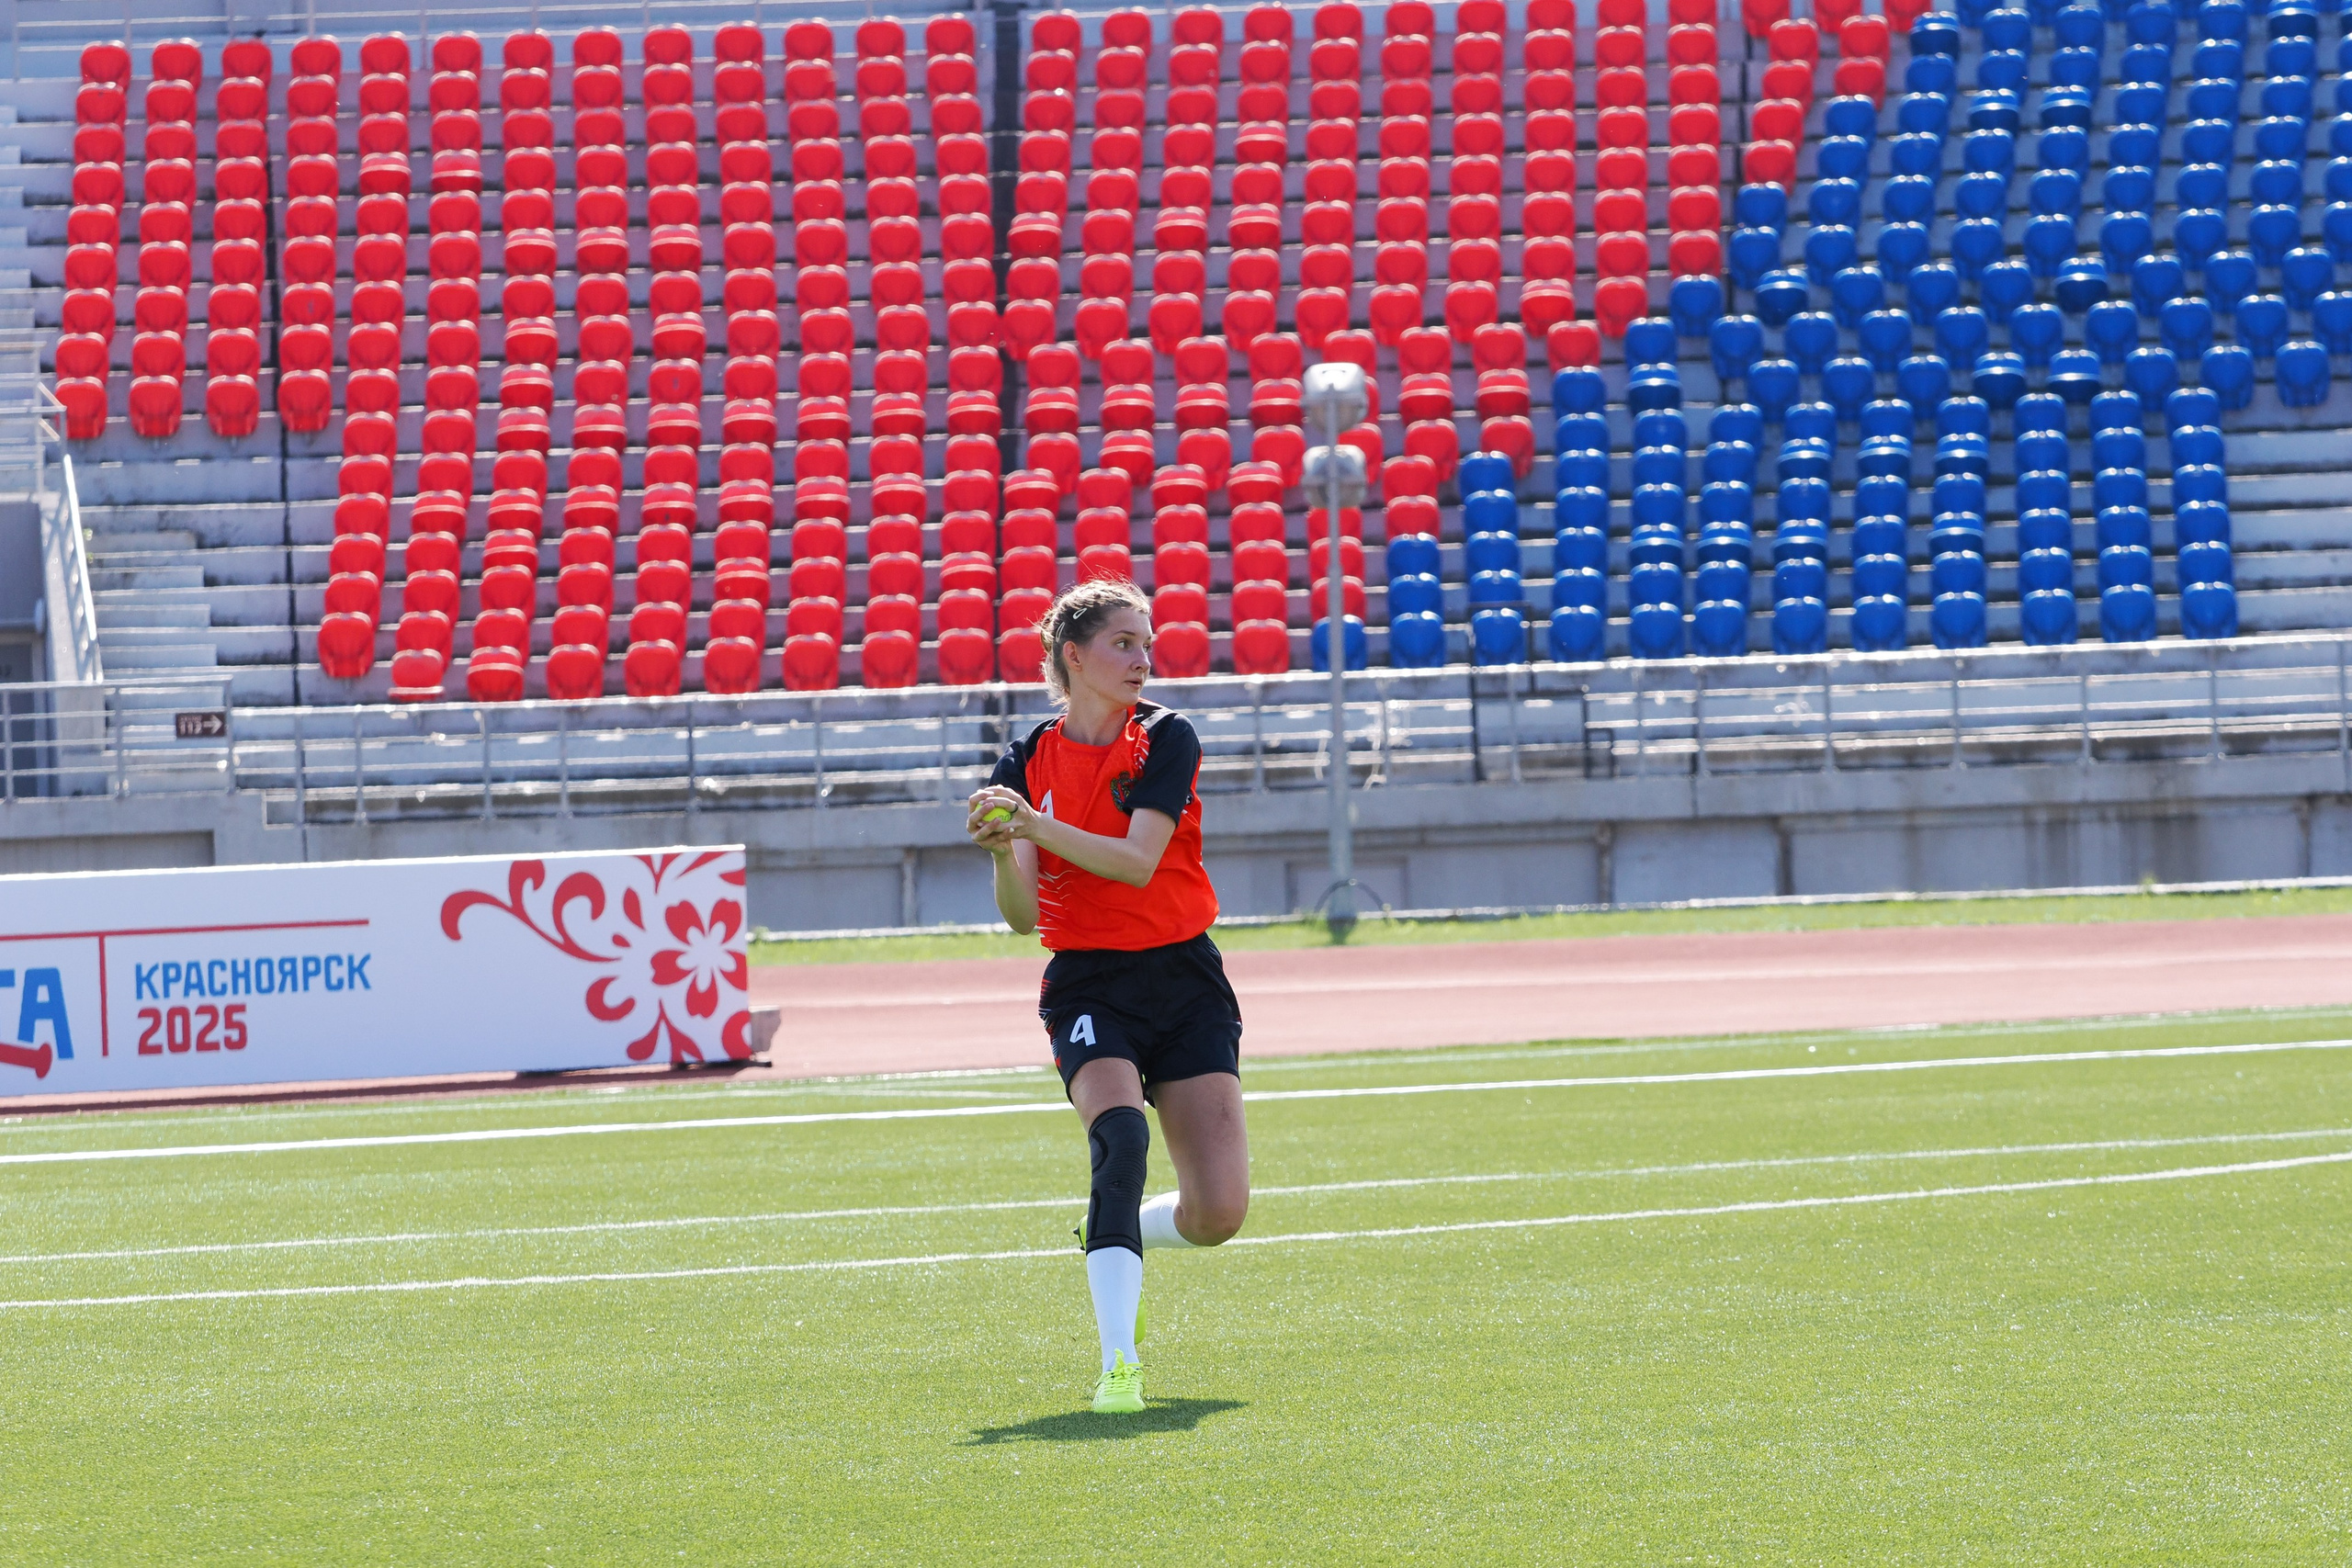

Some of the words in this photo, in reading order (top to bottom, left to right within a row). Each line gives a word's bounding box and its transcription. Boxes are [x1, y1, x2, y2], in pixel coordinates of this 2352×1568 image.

[135, 953, 371, 999] КРАСНОЯРСК
[138, 1004, 247, 1055] 2025
[1069, 1014, 1097, 1046] 4
